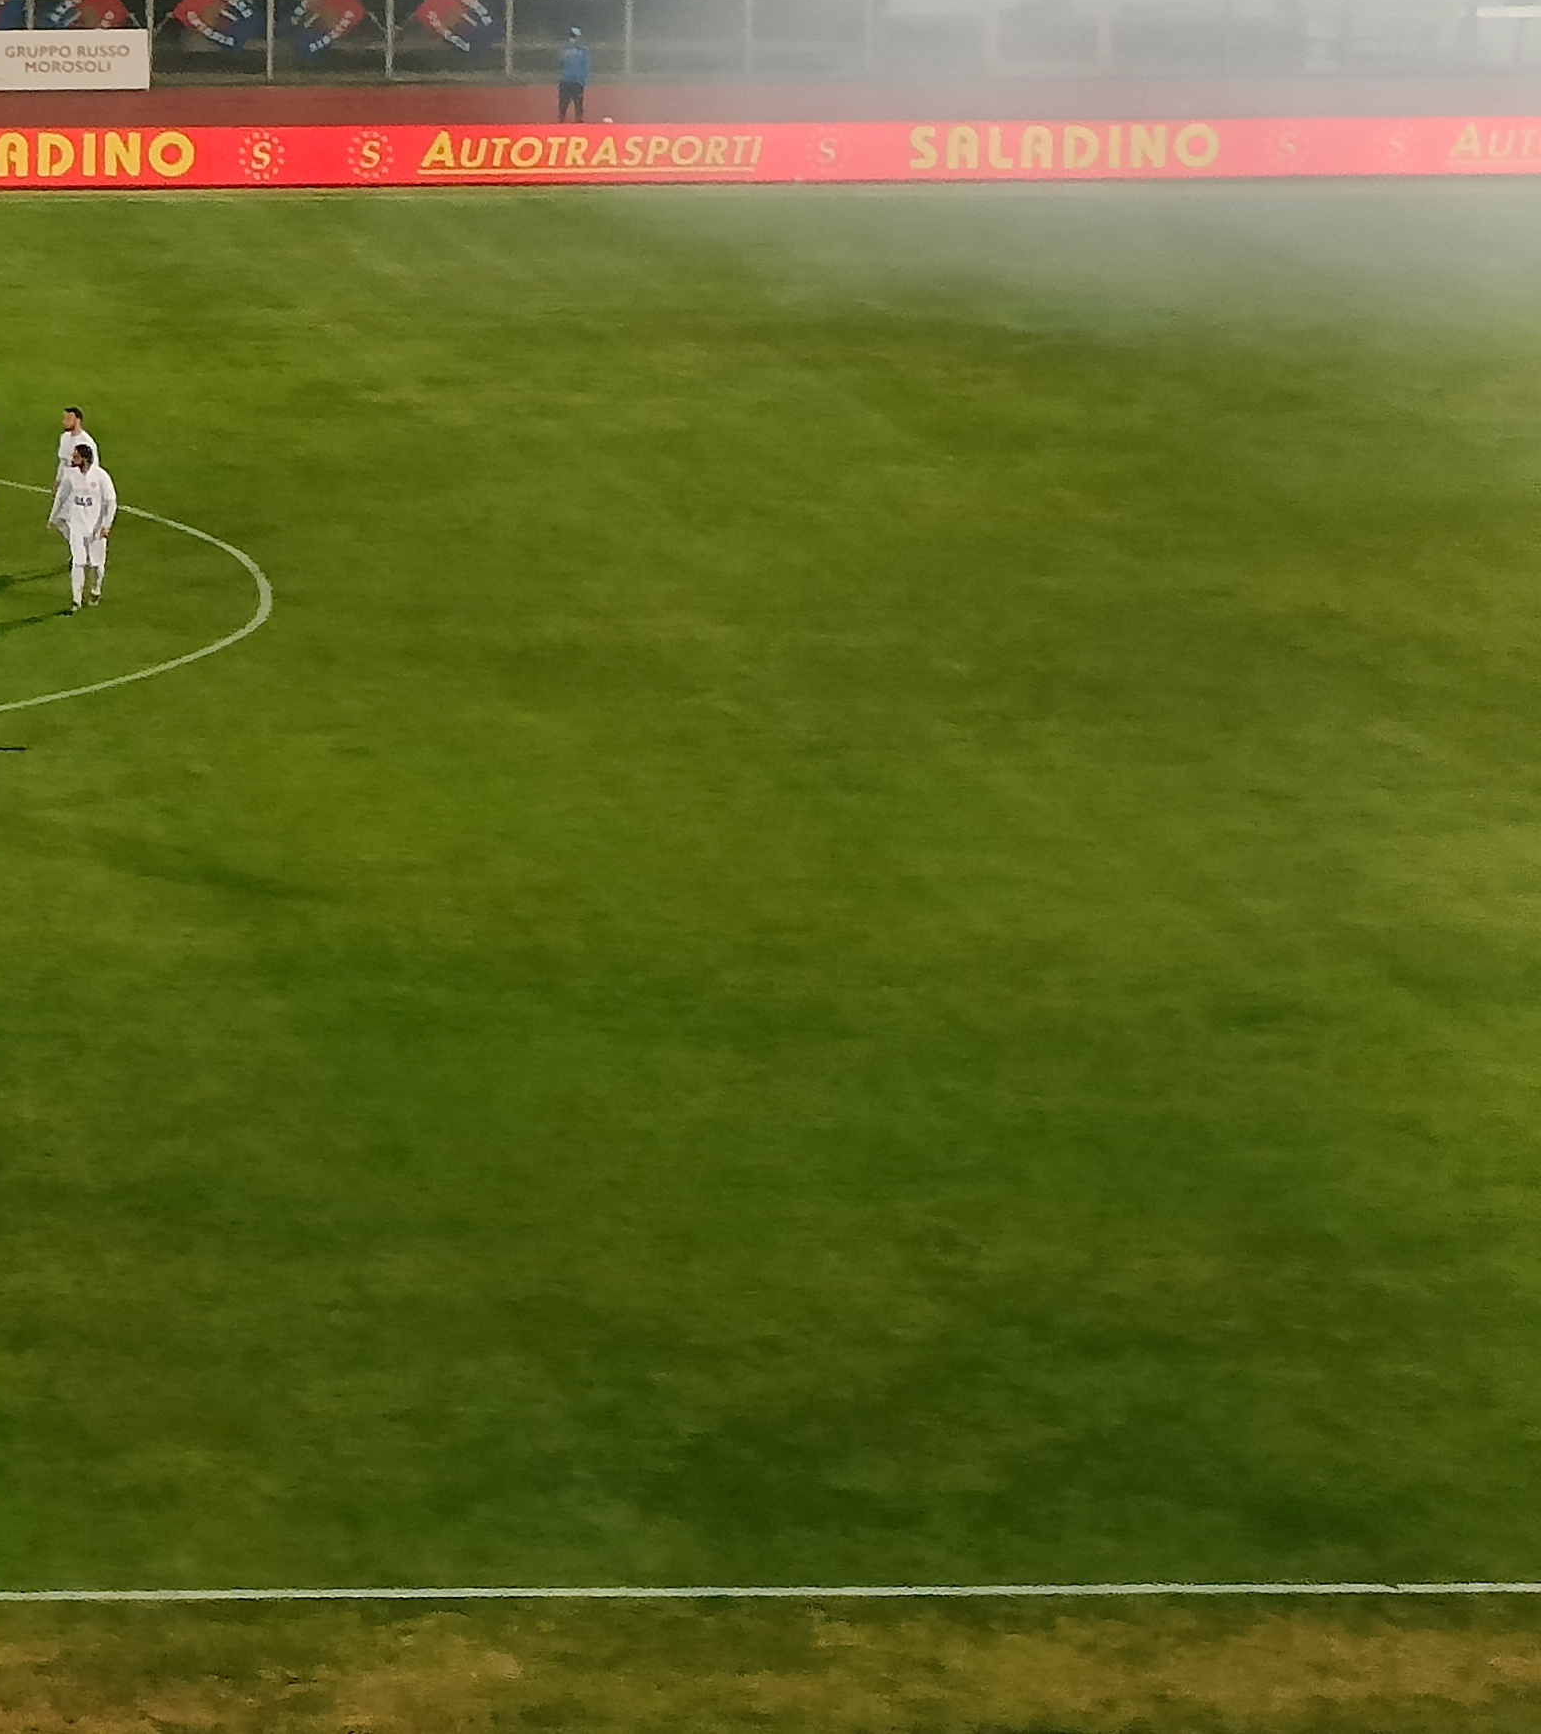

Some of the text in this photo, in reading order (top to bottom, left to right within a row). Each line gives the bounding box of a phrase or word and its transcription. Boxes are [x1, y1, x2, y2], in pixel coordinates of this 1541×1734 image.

[4, 44, 130, 59] GRUPPO RUSSO
[24, 60, 112, 74] MOROSOLI
[421, 129, 764, 168] AUTOTRASPORTI
[909, 122, 1220, 171] SALADINO
[1448, 122, 1541, 158] AUT
